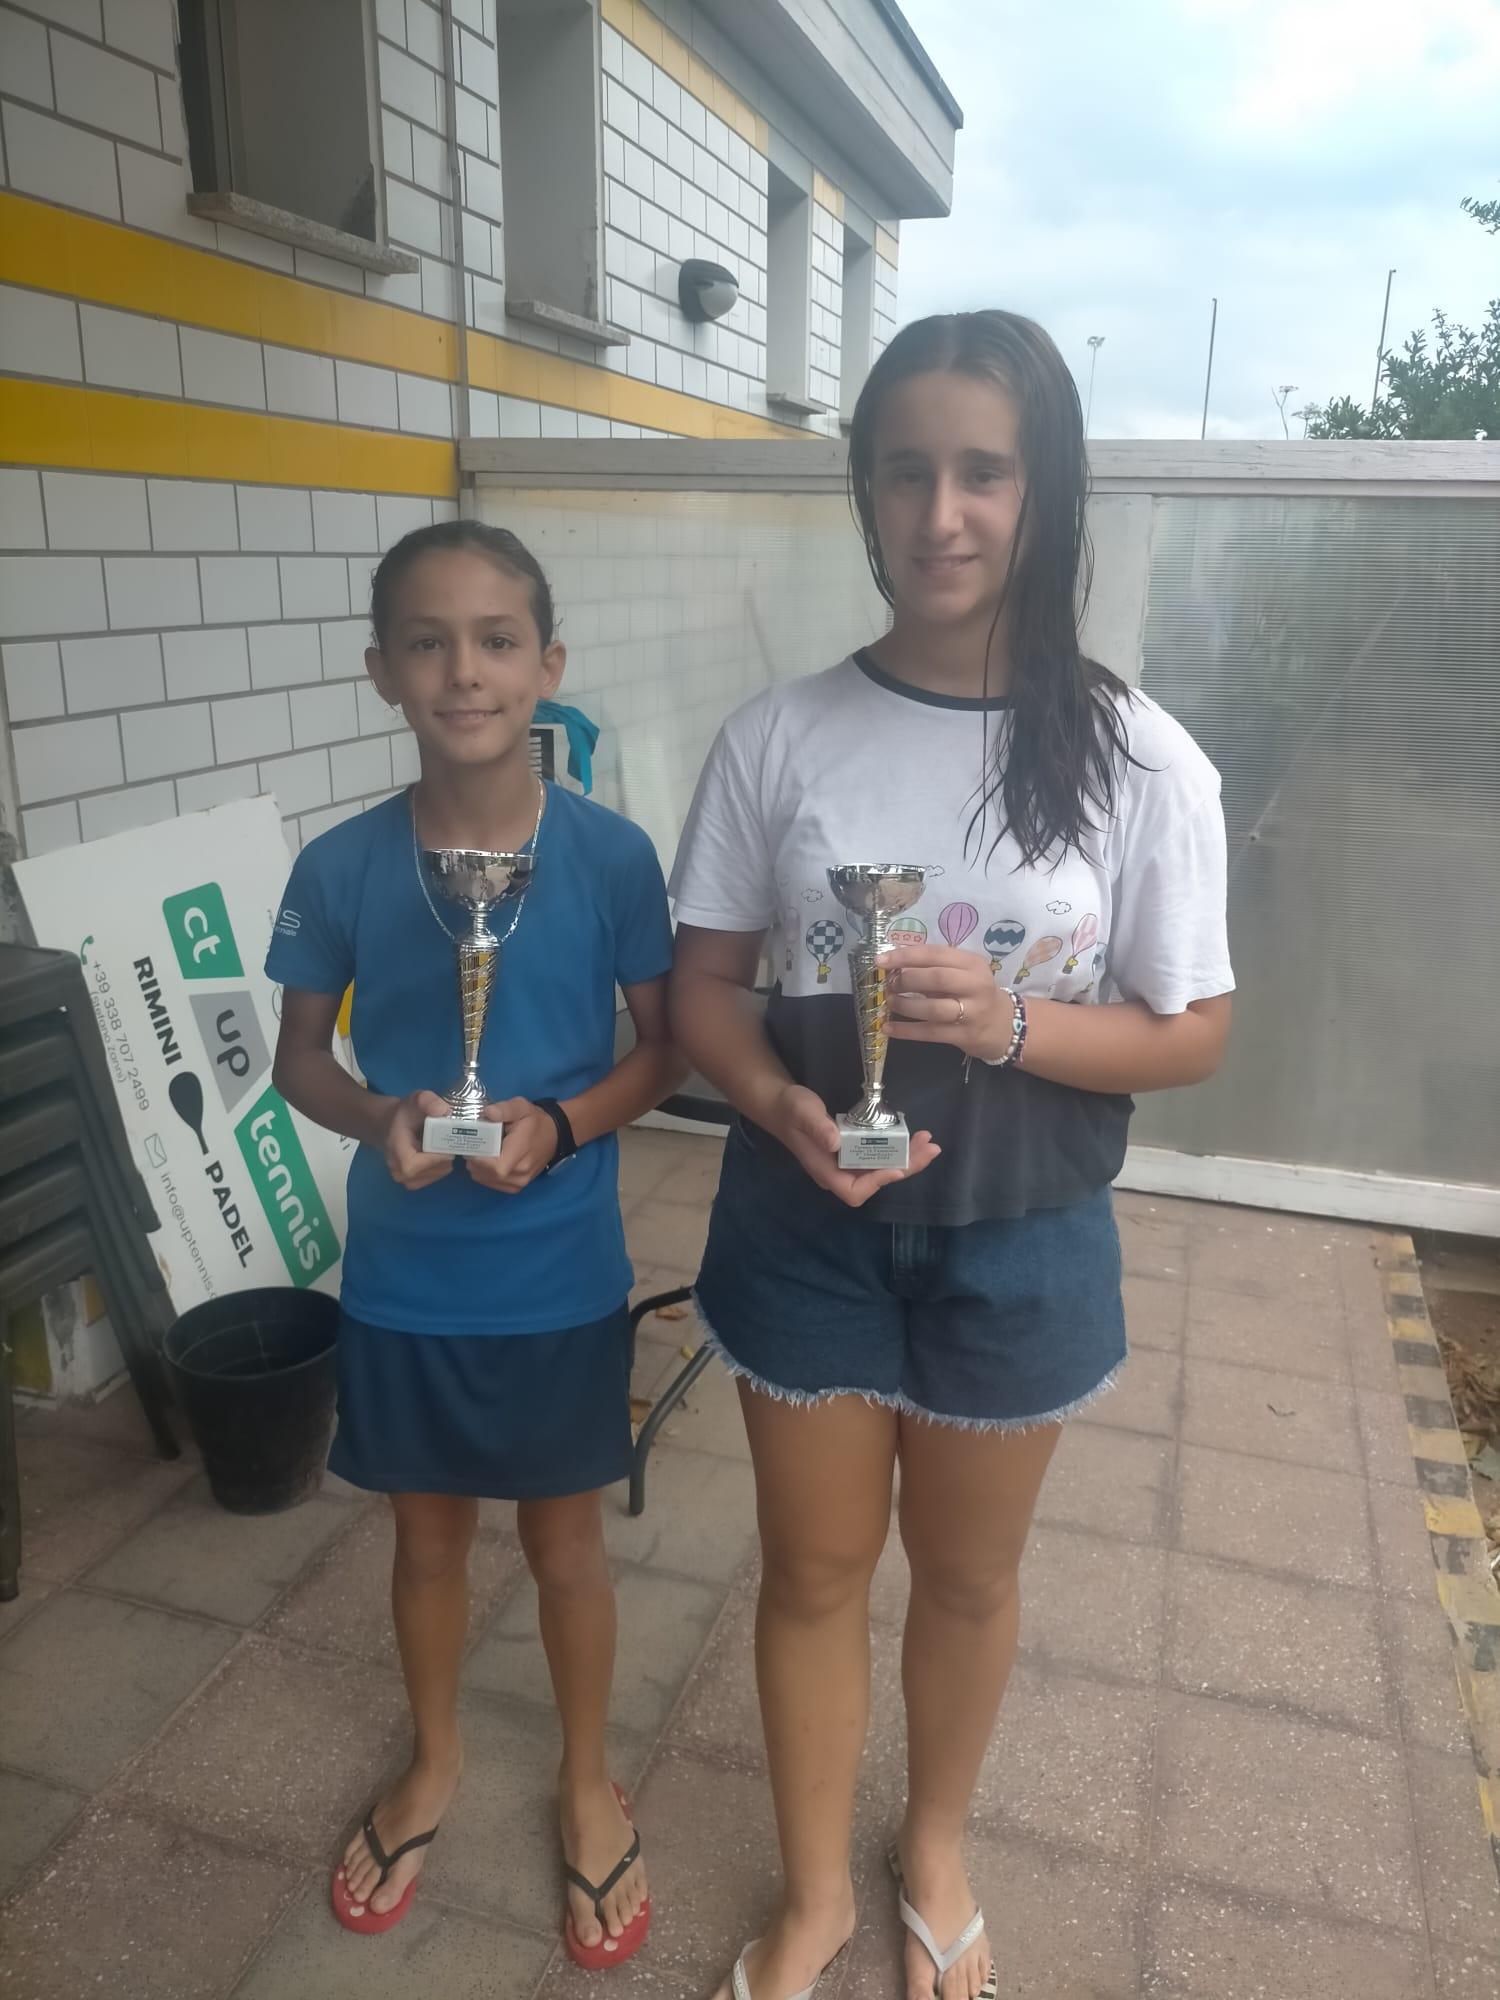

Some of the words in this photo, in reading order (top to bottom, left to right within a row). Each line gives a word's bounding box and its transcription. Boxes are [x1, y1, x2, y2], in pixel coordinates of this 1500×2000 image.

[94, 961, 110, 994] +39
[104, 997, 122, 1030] 338
[116, 1032, 134, 1063] 707
[128, 1067, 150, 1111] 2499
[133, 956, 183, 1067] RIMINI
[205, 1160, 254, 1269] PADEL
[184, 907, 221, 964] ct
[216, 1009, 250, 1077] up
[251, 1109, 321, 1271] tennis
